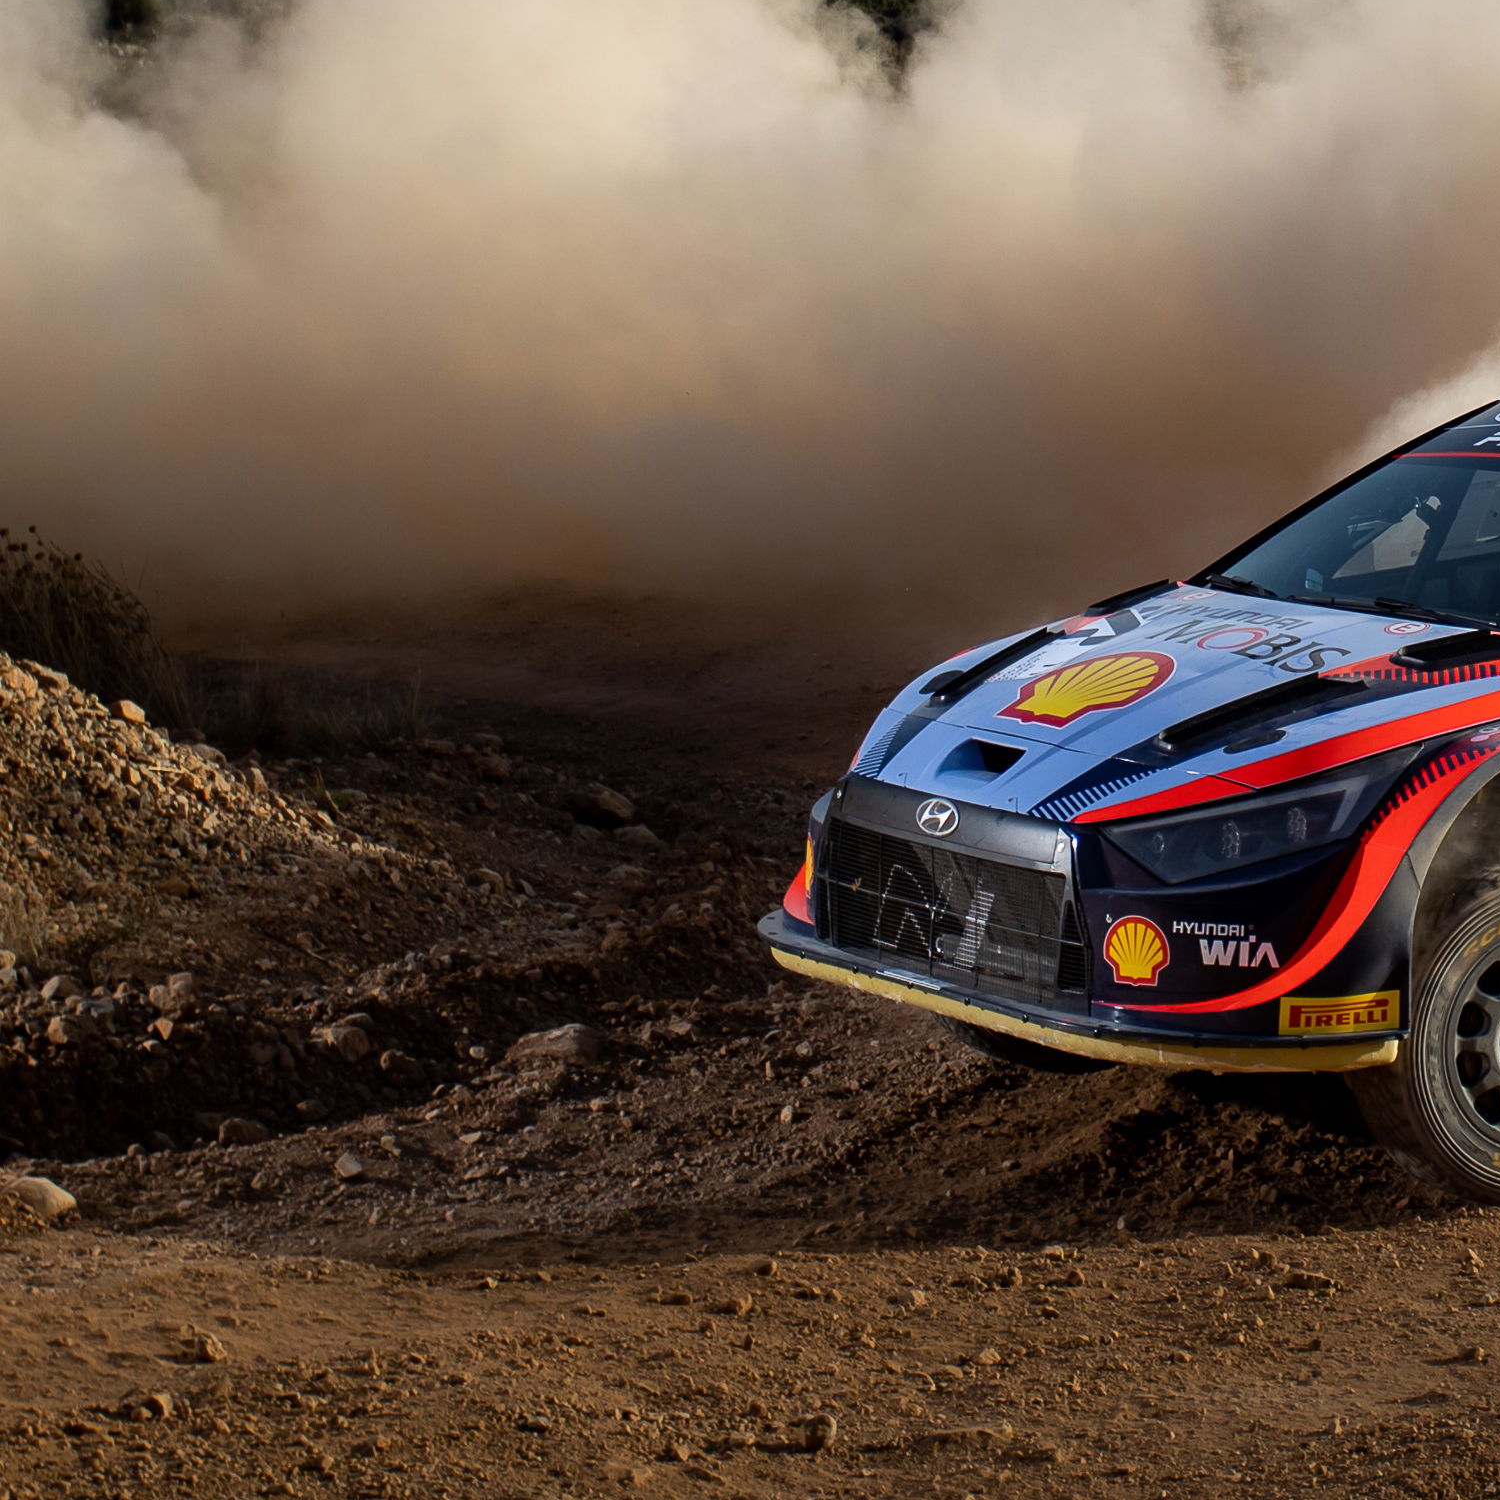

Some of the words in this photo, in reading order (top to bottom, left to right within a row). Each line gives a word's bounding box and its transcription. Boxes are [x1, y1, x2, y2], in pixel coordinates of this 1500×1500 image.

[1177, 604, 1313, 631] HYUNDAI
[1145, 618, 1353, 674] MOBIS
[1172, 920, 1245, 937] HYUNDAI
[1288, 999, 1389, 1029] PIRELLI
